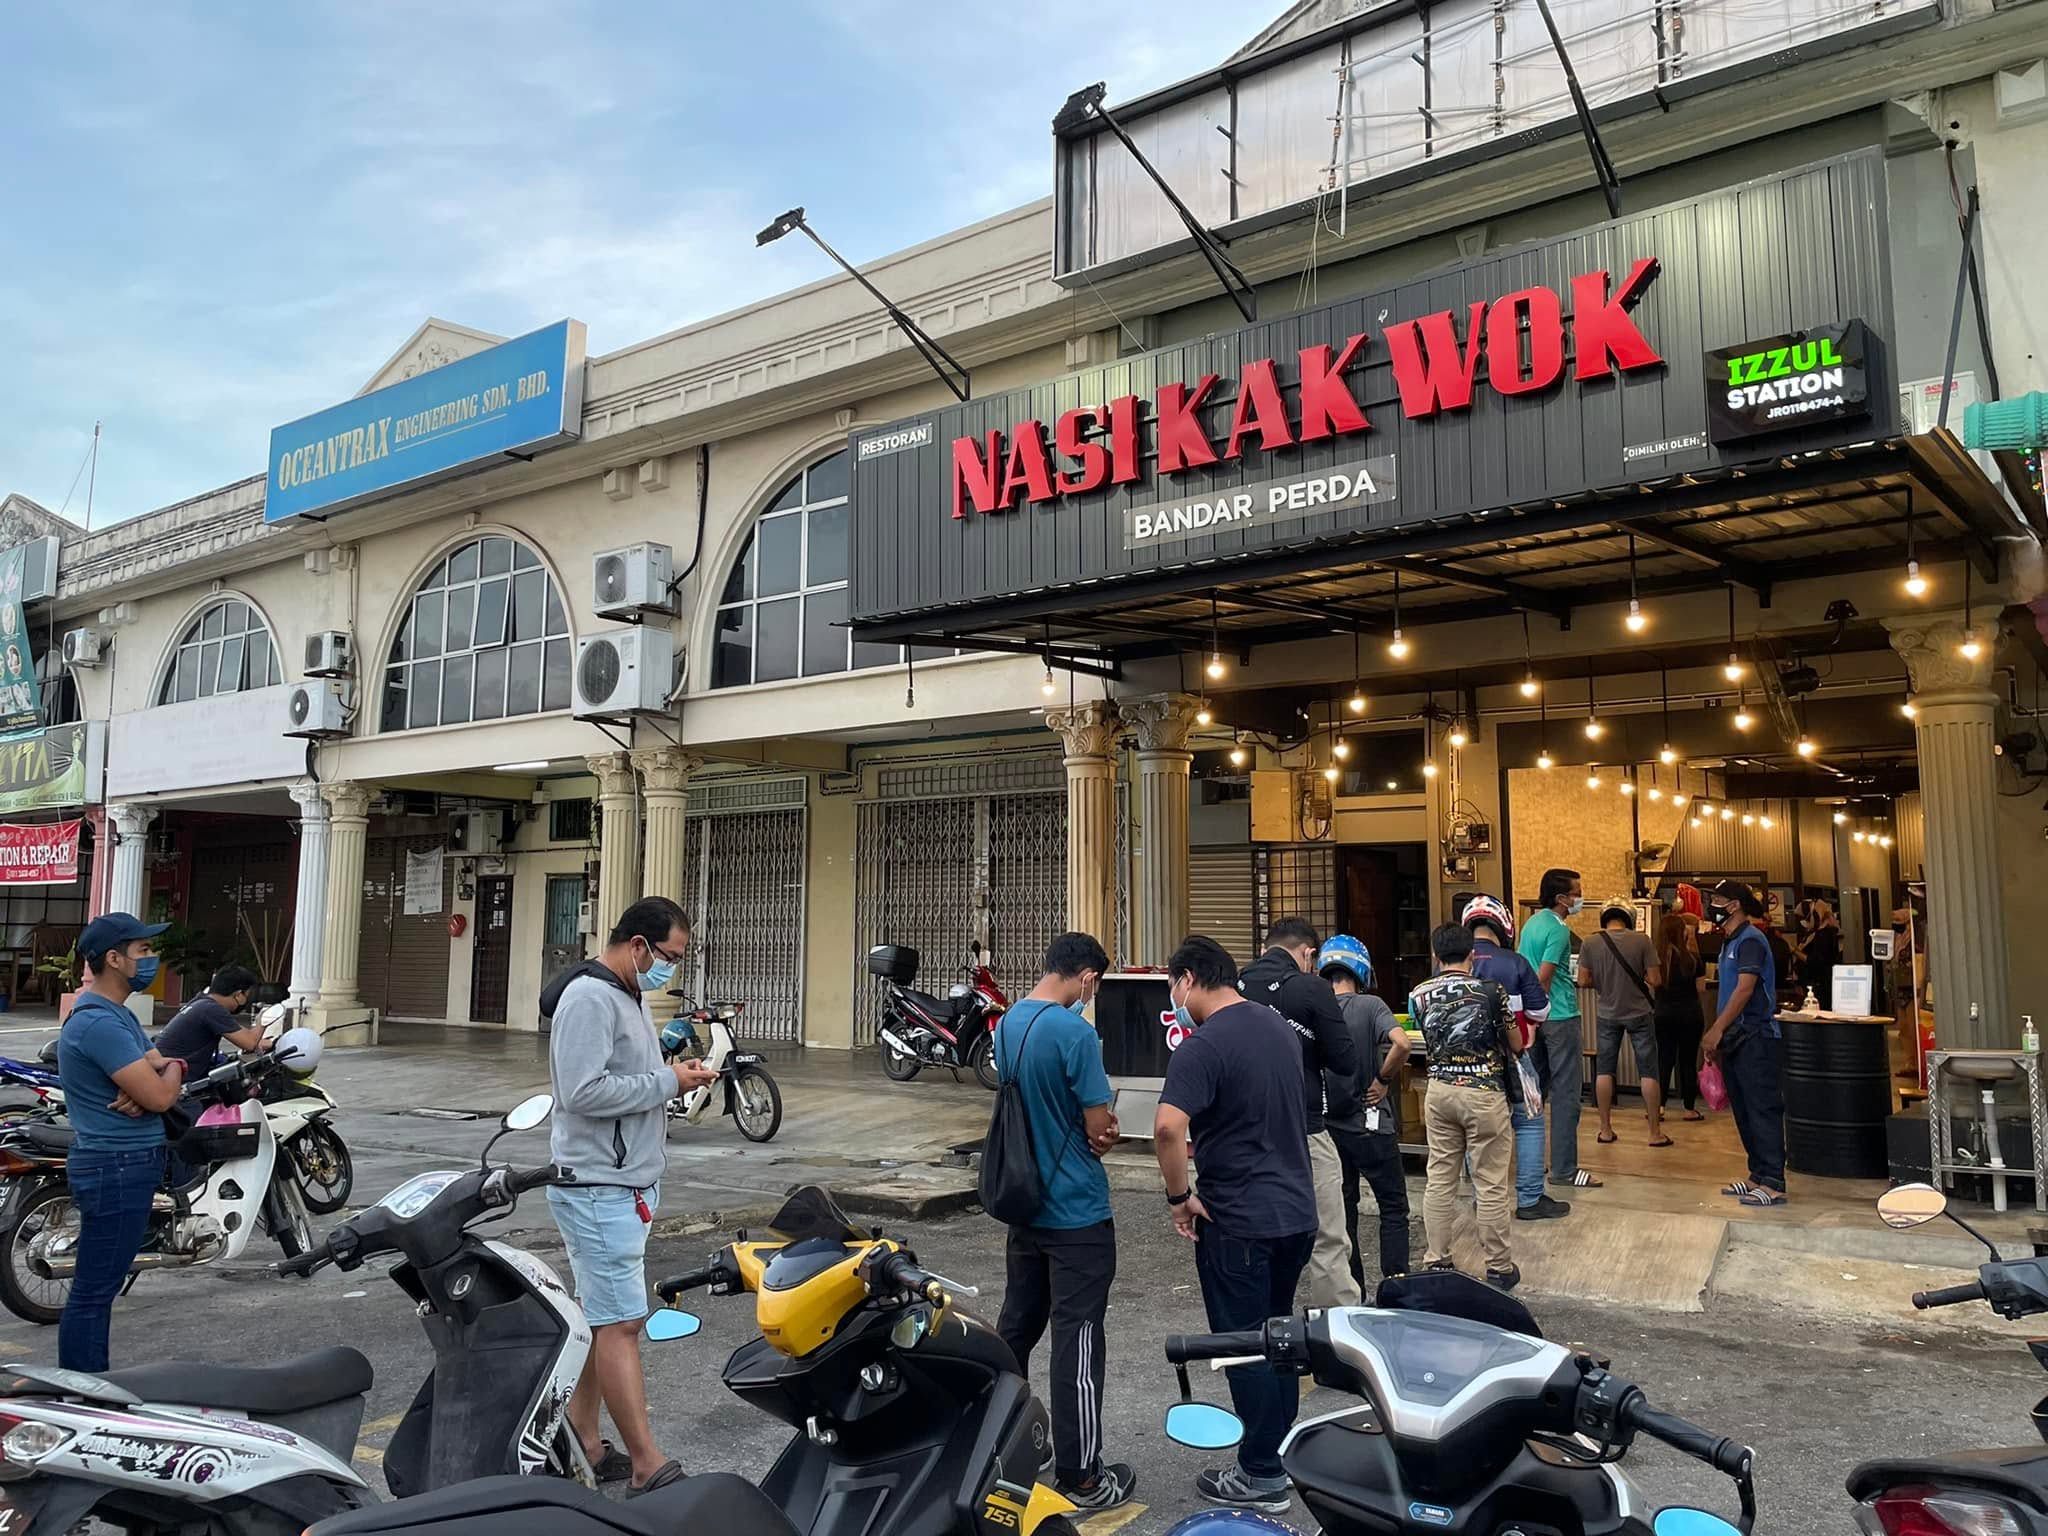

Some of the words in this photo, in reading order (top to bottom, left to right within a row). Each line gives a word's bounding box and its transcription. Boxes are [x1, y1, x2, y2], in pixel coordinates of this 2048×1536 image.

[1727, 338, 1842, 386] IZZUL
[952, 394, 1139, 519] NASI
[1156, 332, 1374, 474] KAK
[1383, 257, 1664, 420] WOK
[1727, 368, 1843, 410] STATION
[278, 417, 391, 491] OCEANTRAX
[395, 394, 478, 444] ENGINEERING
[481, 383, 511, 415] SDN.
[516, 370, 550, 403] BHD.
[861, 427, 927, 457] RESTORAN
[1628, 442, 1669, 458] DIMILIKI
[1670, 436, 1701, 449] OLEH:
[1134, 493, 1254, 539] BANDAR
[1268, 468, 1377, 513] PERDA
[22, 845, 28, 866] &
[983, 1506, 1018, 1527] 155
